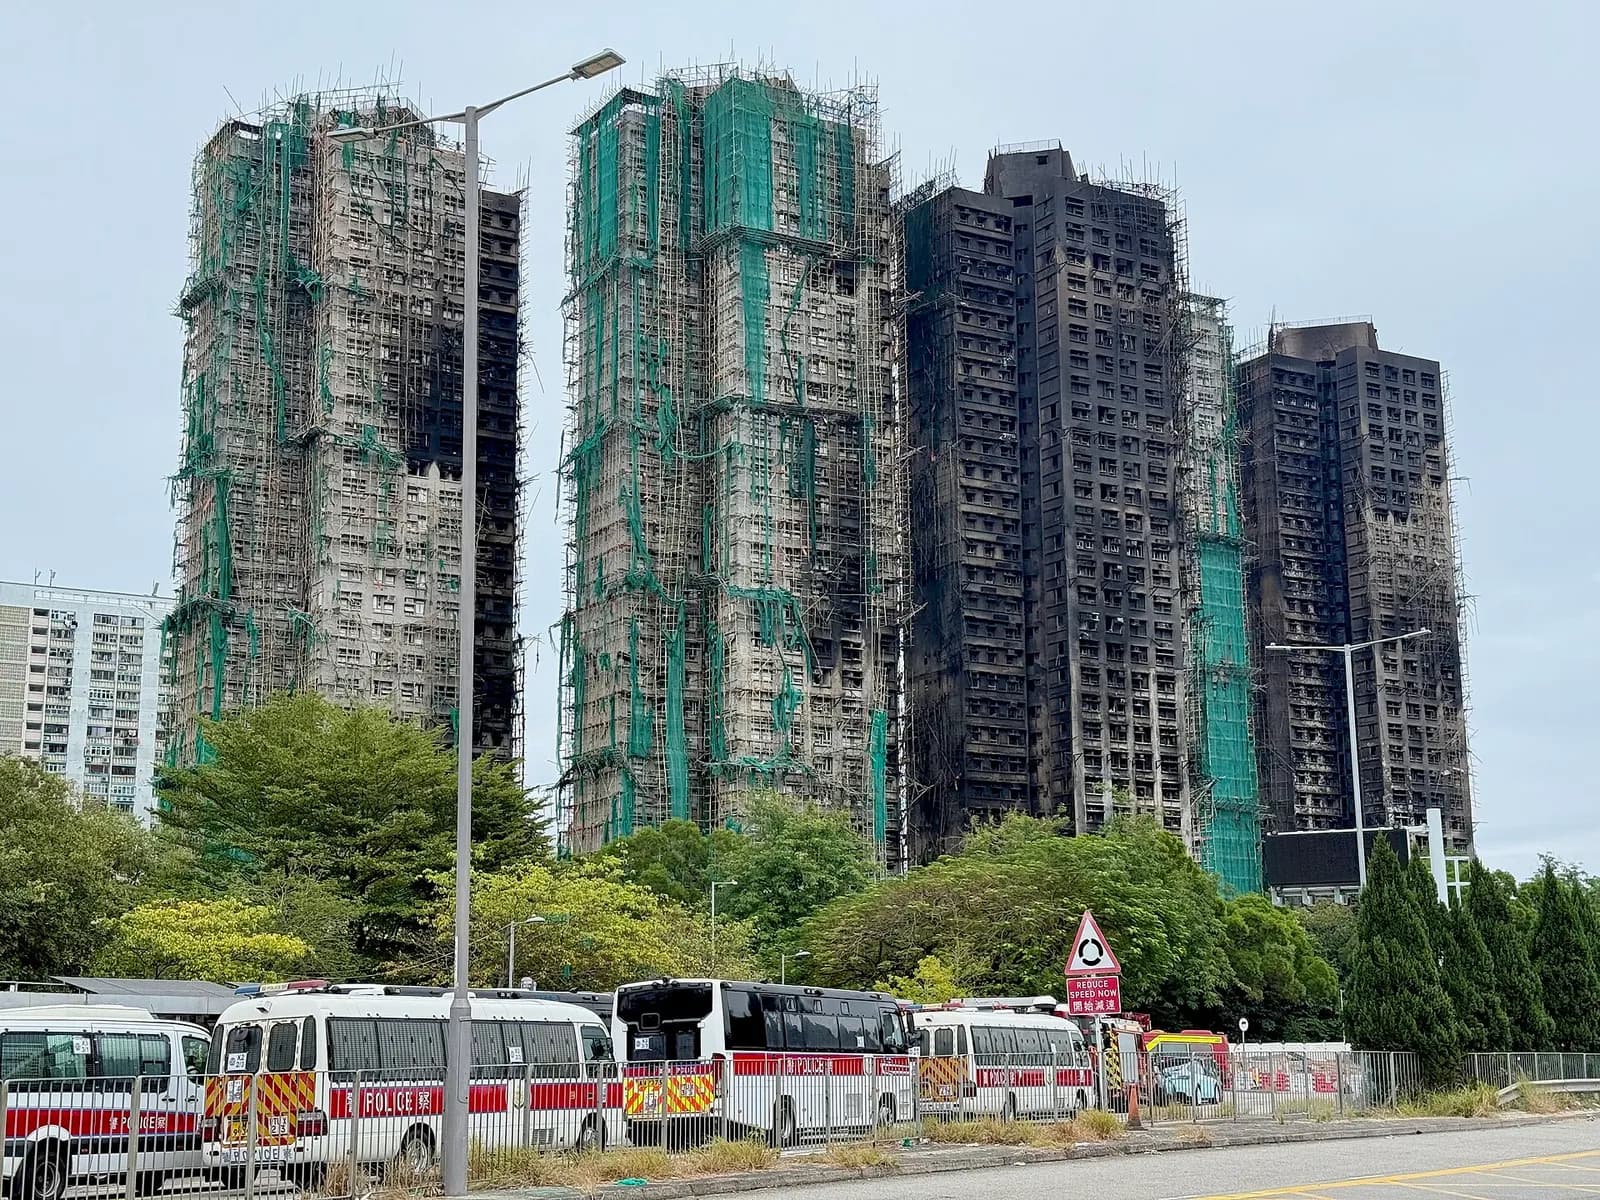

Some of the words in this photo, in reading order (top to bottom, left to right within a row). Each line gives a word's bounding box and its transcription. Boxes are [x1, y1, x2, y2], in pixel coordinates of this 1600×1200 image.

[1076, 980, 1109, 989] REDUCE
[1069, 990, 1096, 999] SPEED
[1097, 989, 1117, 998] NOW
[1073, 999, 1116, 1012] 開始減速
[798, 1058, 825, 1074] POLICE
[418, 1091, 430, 1110] 察
